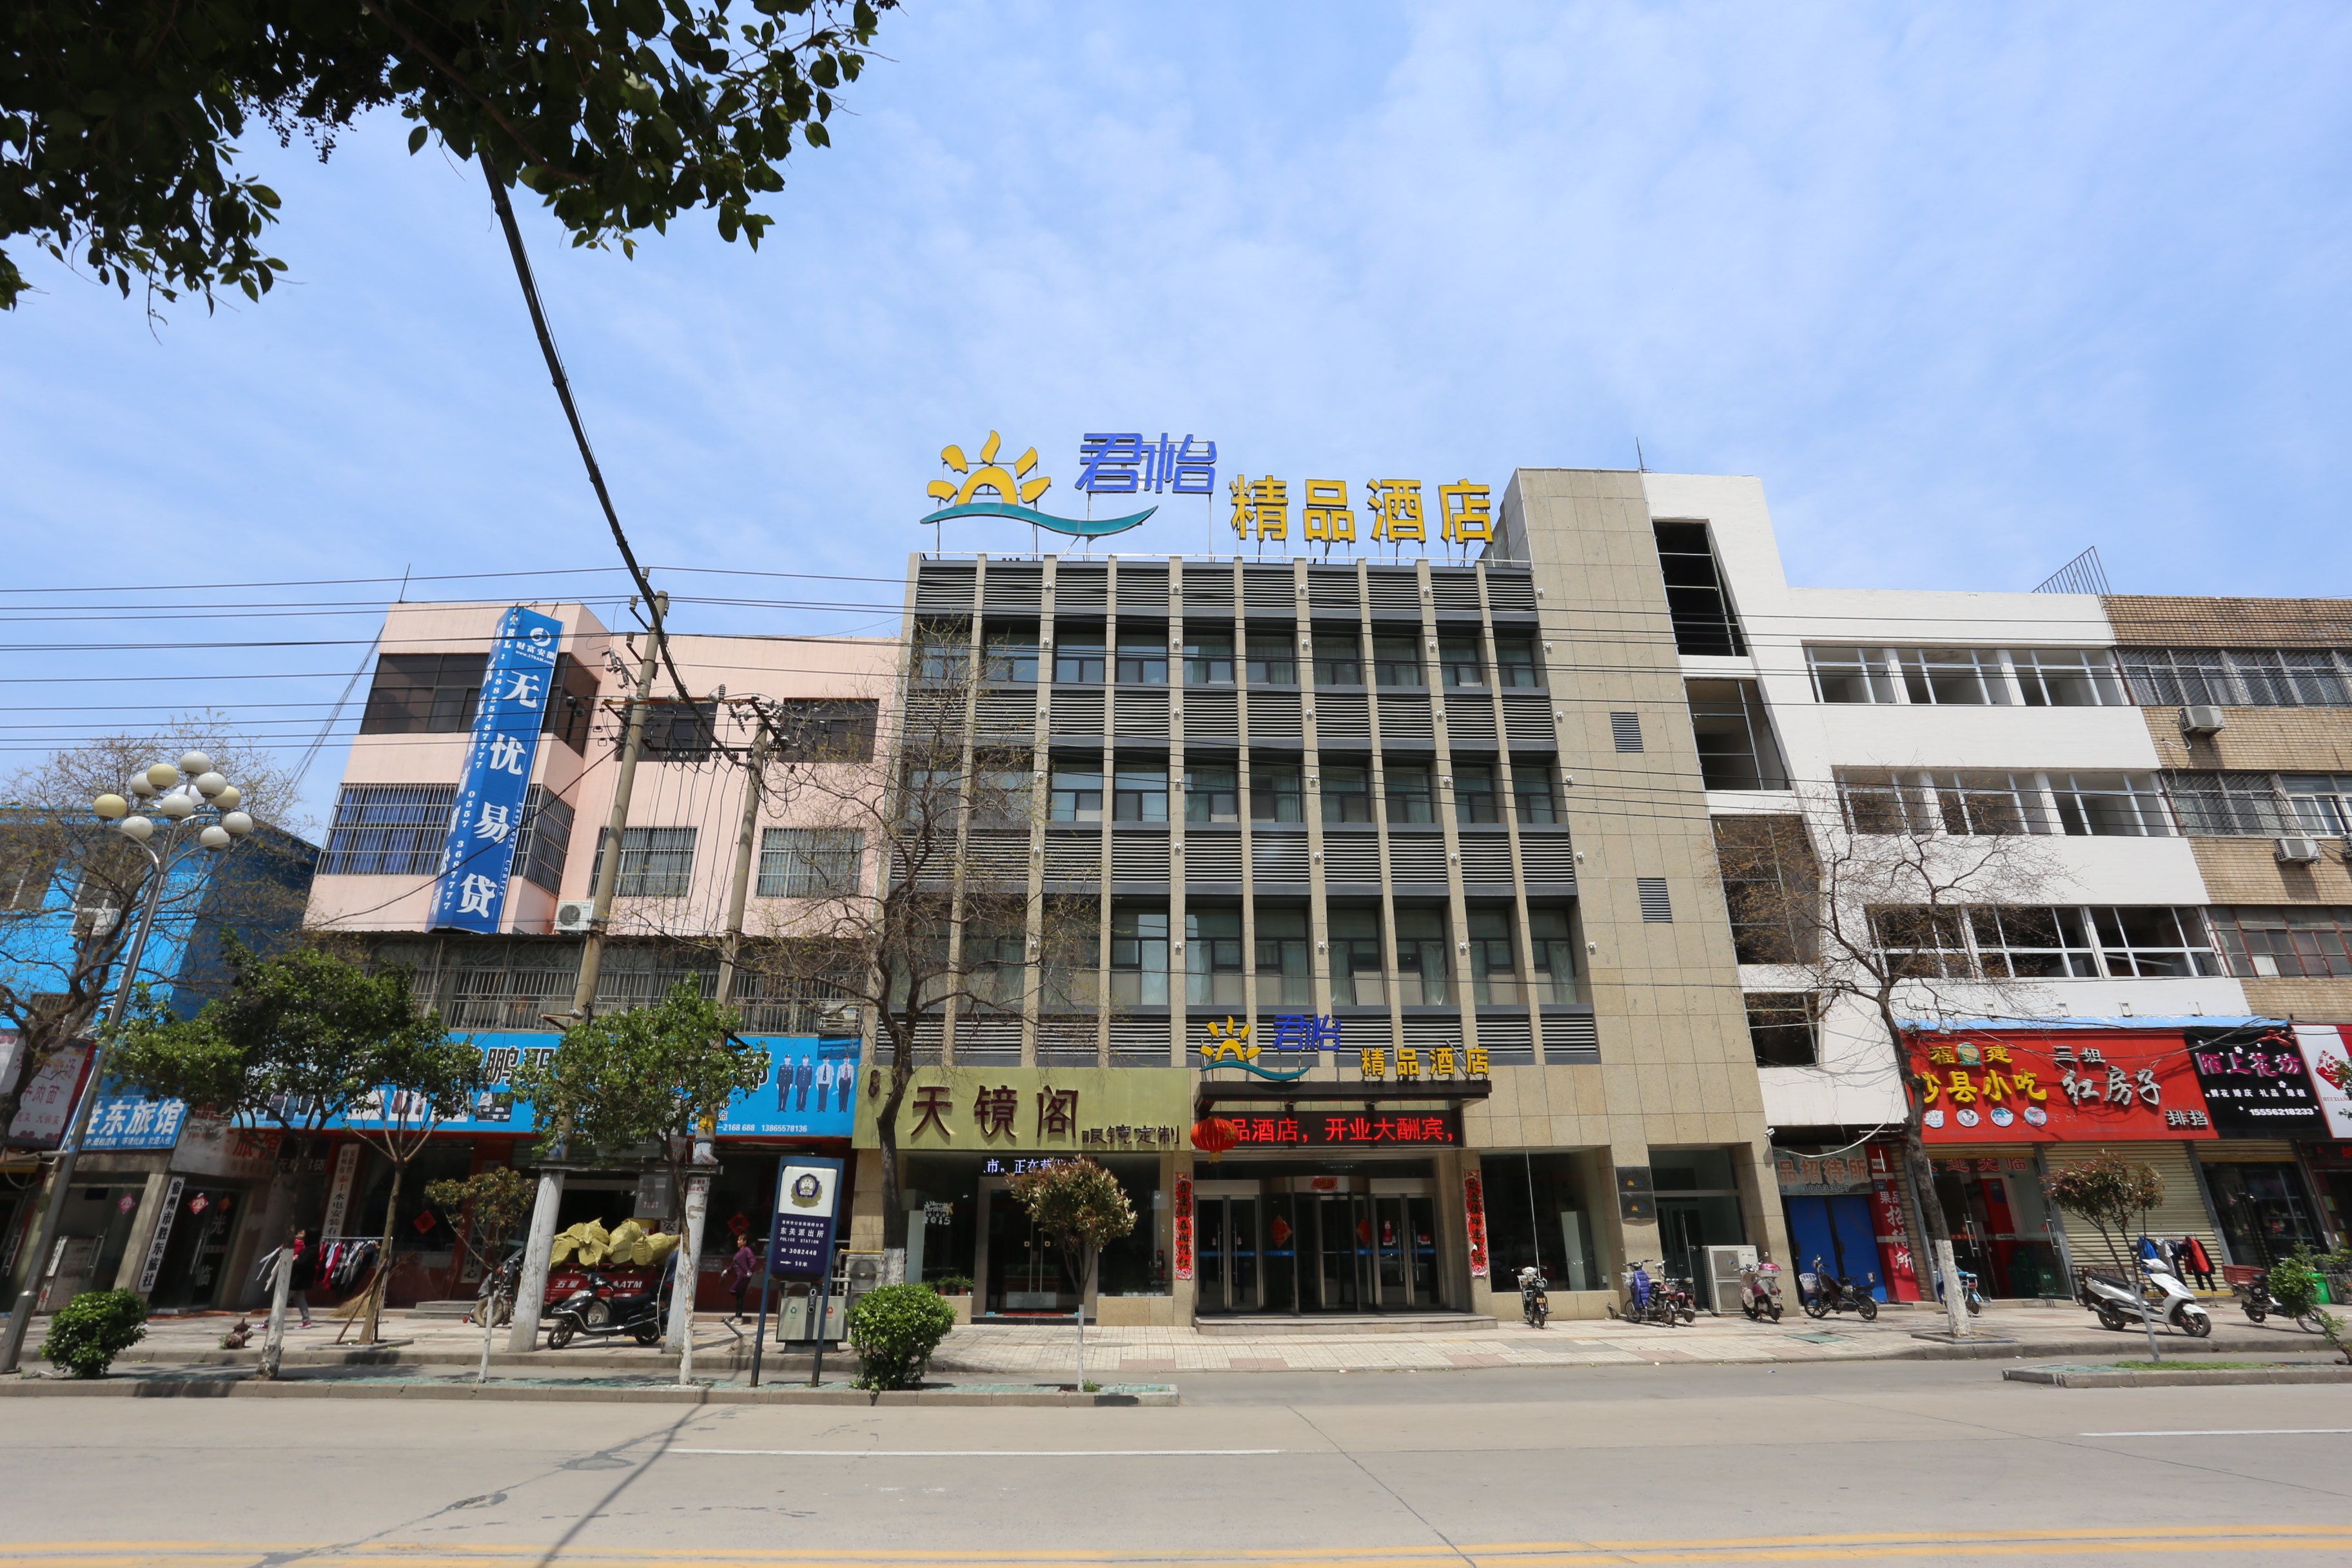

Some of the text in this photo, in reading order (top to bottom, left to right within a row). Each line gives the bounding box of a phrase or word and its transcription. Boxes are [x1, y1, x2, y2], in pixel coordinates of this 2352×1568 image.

[1075, 433, 1493, 544] 君怡 精品酒店
[456, 670, 540, 919] 无忧易贷
[462, 790, 476, 828] 0557
[444, 840, 464, 910] 3687777
[499, 860, 511, 896] Centre
[1272, 1014, 1489, 1076] 君怡 精品酒店
[1929, 1045, 2013, 1065] 福建
[2053, 1046, 2106, 1063] 三姐
[2061, 1066, 2161, 1105] 红房子
[2210, 1089, 2230, 1097] 鲜花
[2232, 1089, 2253, 1097] 婚庆
[2259, 1089, 2279, 1097] 礼品
[910, 1084, 1079, 1139] 天镜阁
[2165, 1110, 2208, 1126] 排挡
[1082, 1124, 1180, 1144] 眼镜定制
[1778, 1158, 1872, 1184] 品招待所
[1931, 1158, 2027, 1172] 迎光临
[1803, 1184, 1850, 1193] 3083327
[142, 1181, 182, 1287] 宿州市胜东旅社
[780, 1227, 824, 1238] 东关派出所
